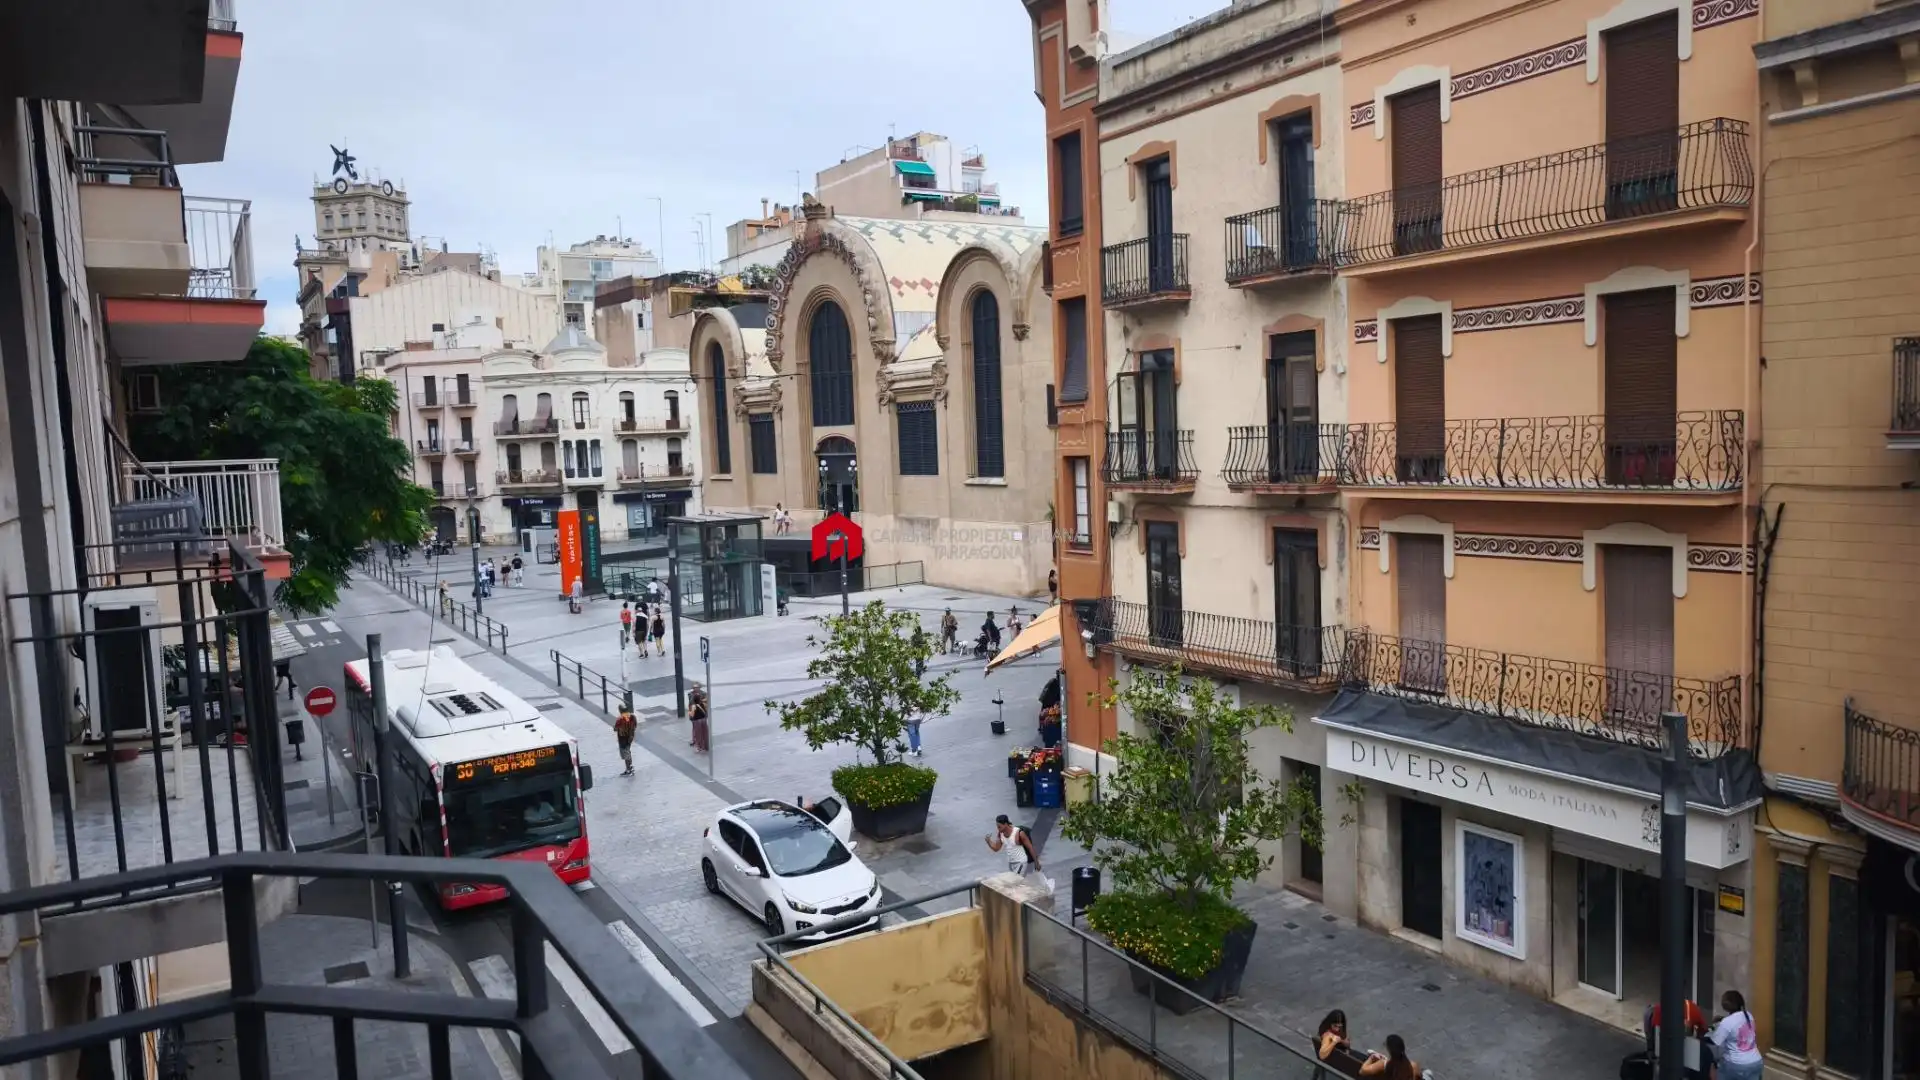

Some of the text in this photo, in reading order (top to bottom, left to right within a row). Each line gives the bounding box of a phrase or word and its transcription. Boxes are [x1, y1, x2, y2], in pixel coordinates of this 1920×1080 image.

[1351, 740, 1494, 796] DIVERSA
[1508, 784, 1617, 820] MODA ITALIANA
